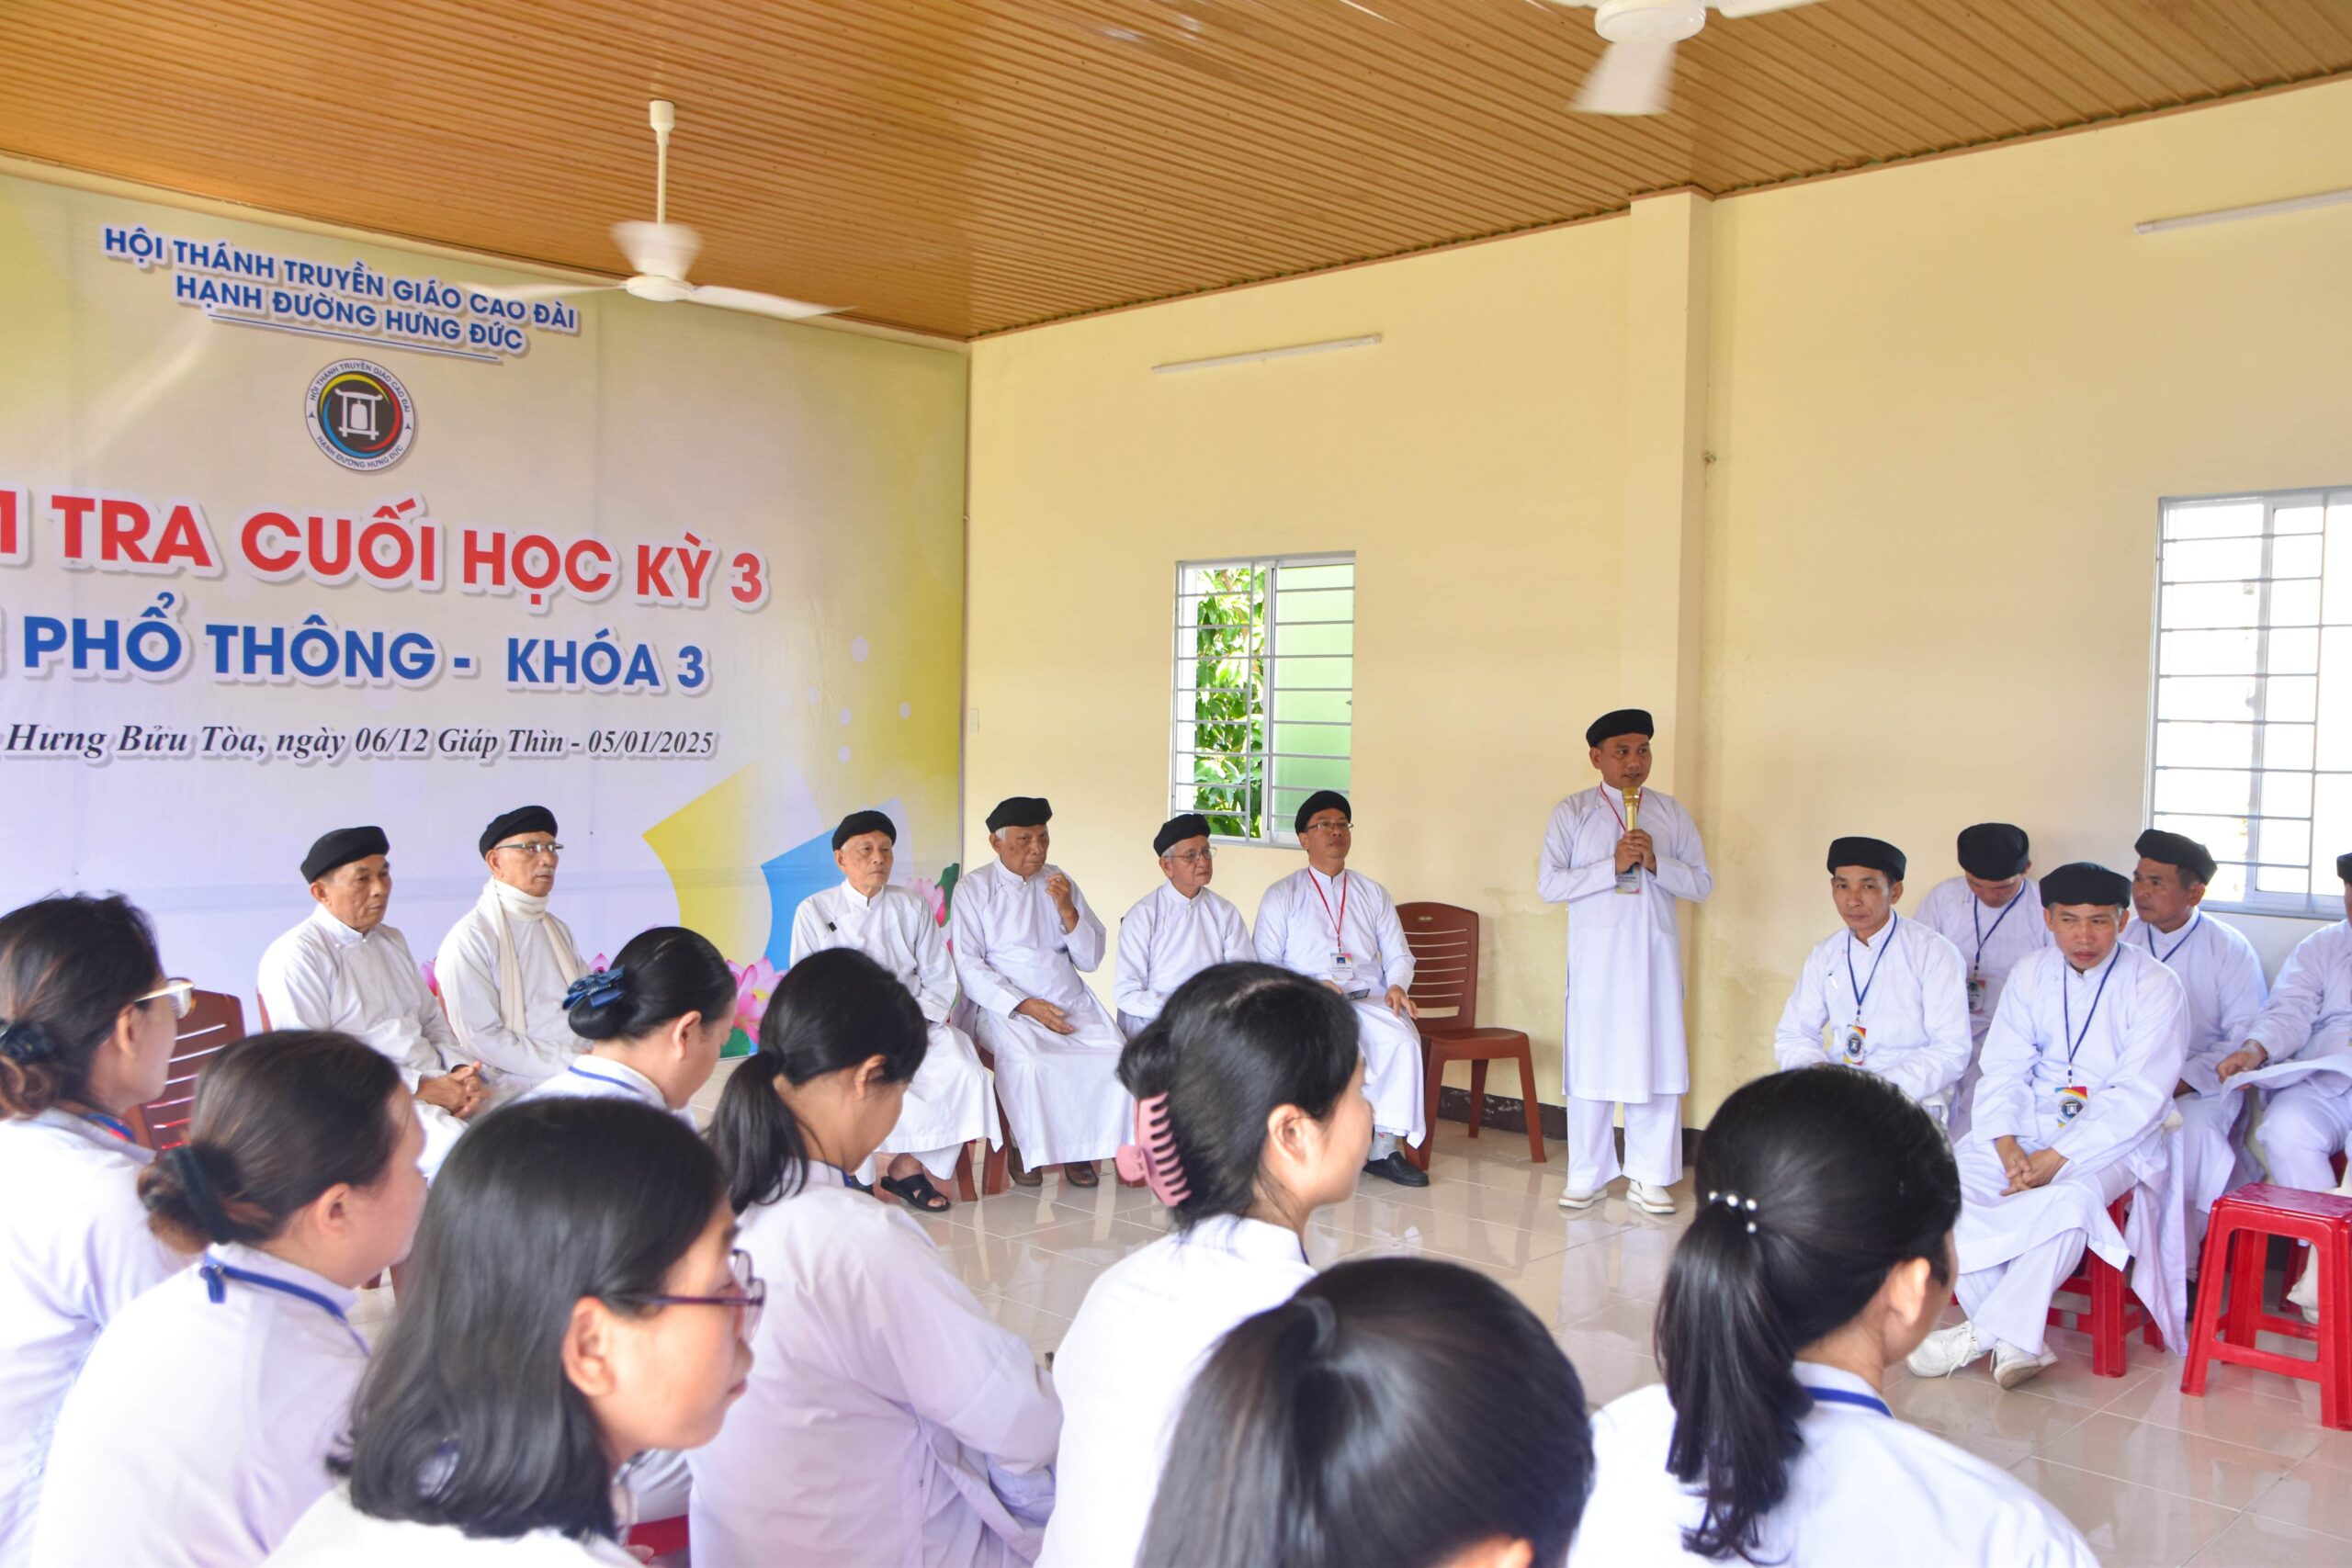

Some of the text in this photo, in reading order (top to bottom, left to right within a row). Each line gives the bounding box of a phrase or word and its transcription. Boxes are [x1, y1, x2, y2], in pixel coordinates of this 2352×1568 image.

[106, 227, 574, 329] HỘI THÁNH TRUYỀN GIÁO CAO ĐÀI
[176, 275, 523, 349] HẠNH ĐƯỜNG HƯNG ĐỨC
[51, 494, 211, 567] TRA
[241, 499, 435, 581] CUỐI
[463, 530, 612, 605] HỌC
[637, 533, 711, 599] KỲ
[731, 553, 762, 603] 3
[24, 592, 183, 672] PHỔ
[206, 614, 436, 680] THÔNG
[507, 629, 660, 686] KHÓA
[678, 646, 705, 688] 3
[6, 724, 107, 758] Hưng
[118, 725, 187, 751] Bửu
[201, 726, 266, 756] Tòa,
[276, 727, 346, 759] ngày
[355, 728, 429, 752] 06/12
[438, 728, 498, 759] Giáp
[507, 729, 564, 752] Thìn
[587, 730, 714, 753] 05/01/2025
